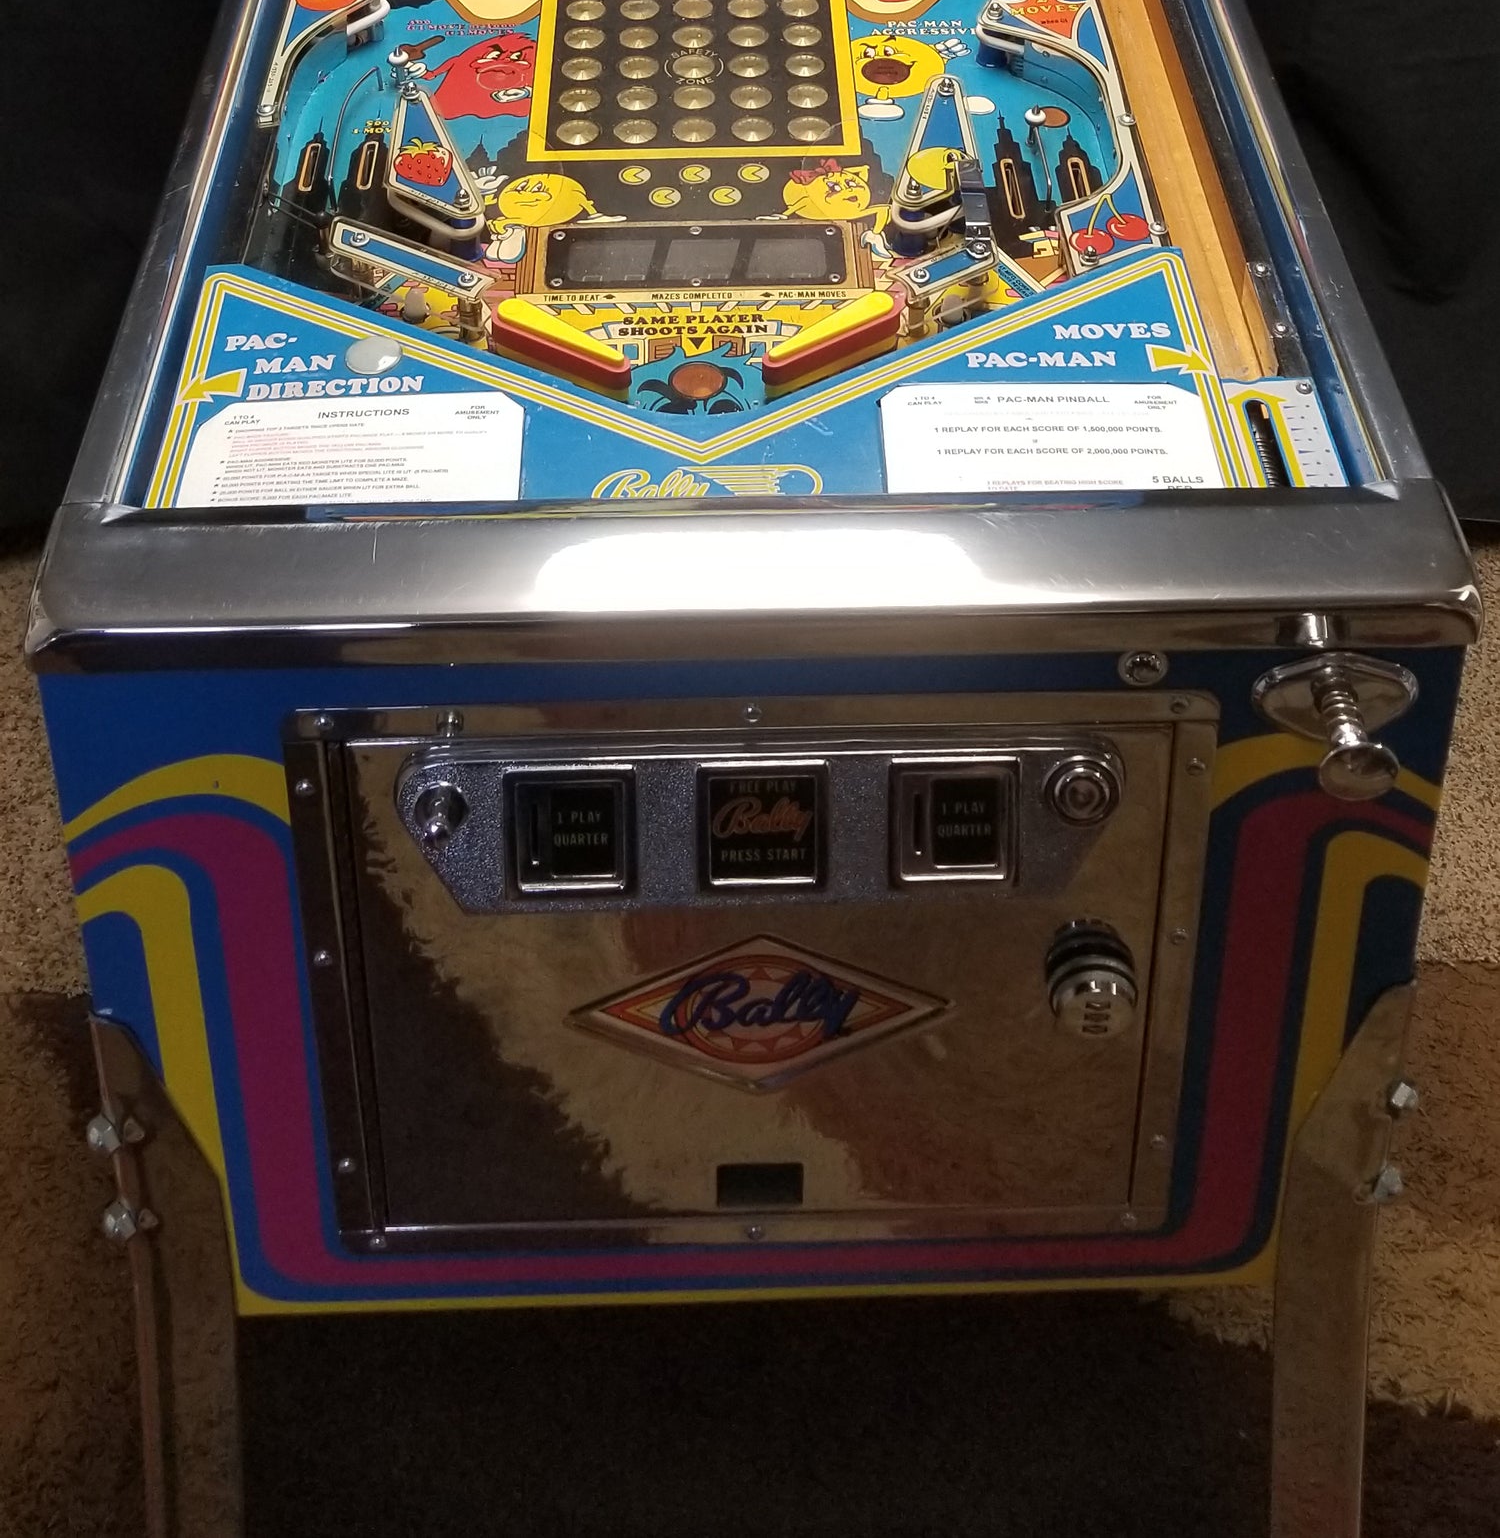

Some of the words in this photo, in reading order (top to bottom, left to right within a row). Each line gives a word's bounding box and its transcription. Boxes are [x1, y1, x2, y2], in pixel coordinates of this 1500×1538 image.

[1010, 4, 1080, 17] MOVES
[887, 20, 963, 28] PAC-MAN
[670, 48, 719, 59] SAFETY
[676, 77, 715, 85] ZONE
[683, 292, 733, 300] COMPLETED
[623, 316, 680, 326] SAME
[686, 314, 765, 324] PLAYER
[618, 326, 699, 337] SHOOTS
[703, 324, 769, 335] AGAIN
[1054, 322, 1171, 340] MOVES
[224, 332, 298, 352] PAC-
[253, 354, 337, 374] MAN
[965, 351, 1116, 368] PAC-MAN
[246, 375, 425, 401] DIRECTION
[317, 408, 410, 419] INSTRUCTIONS
[591, 468, 711, 498] Bally
[1162, 476, 1205, 484] BALLS
[771, 779, 798, 793] PLAY
[955, 801, 986, 815] PLAY
[569, 811, 602, 824] PLAY
[712, 796, 812, 843] Bally
[936, 824, 993, 839] QUARTER
[553, 832, 609, 847] QUARTER
[721, 848, 762, 862] PRESS
[766, 847, 807, 861] START
[659, 971, 860, 1038] Bally
